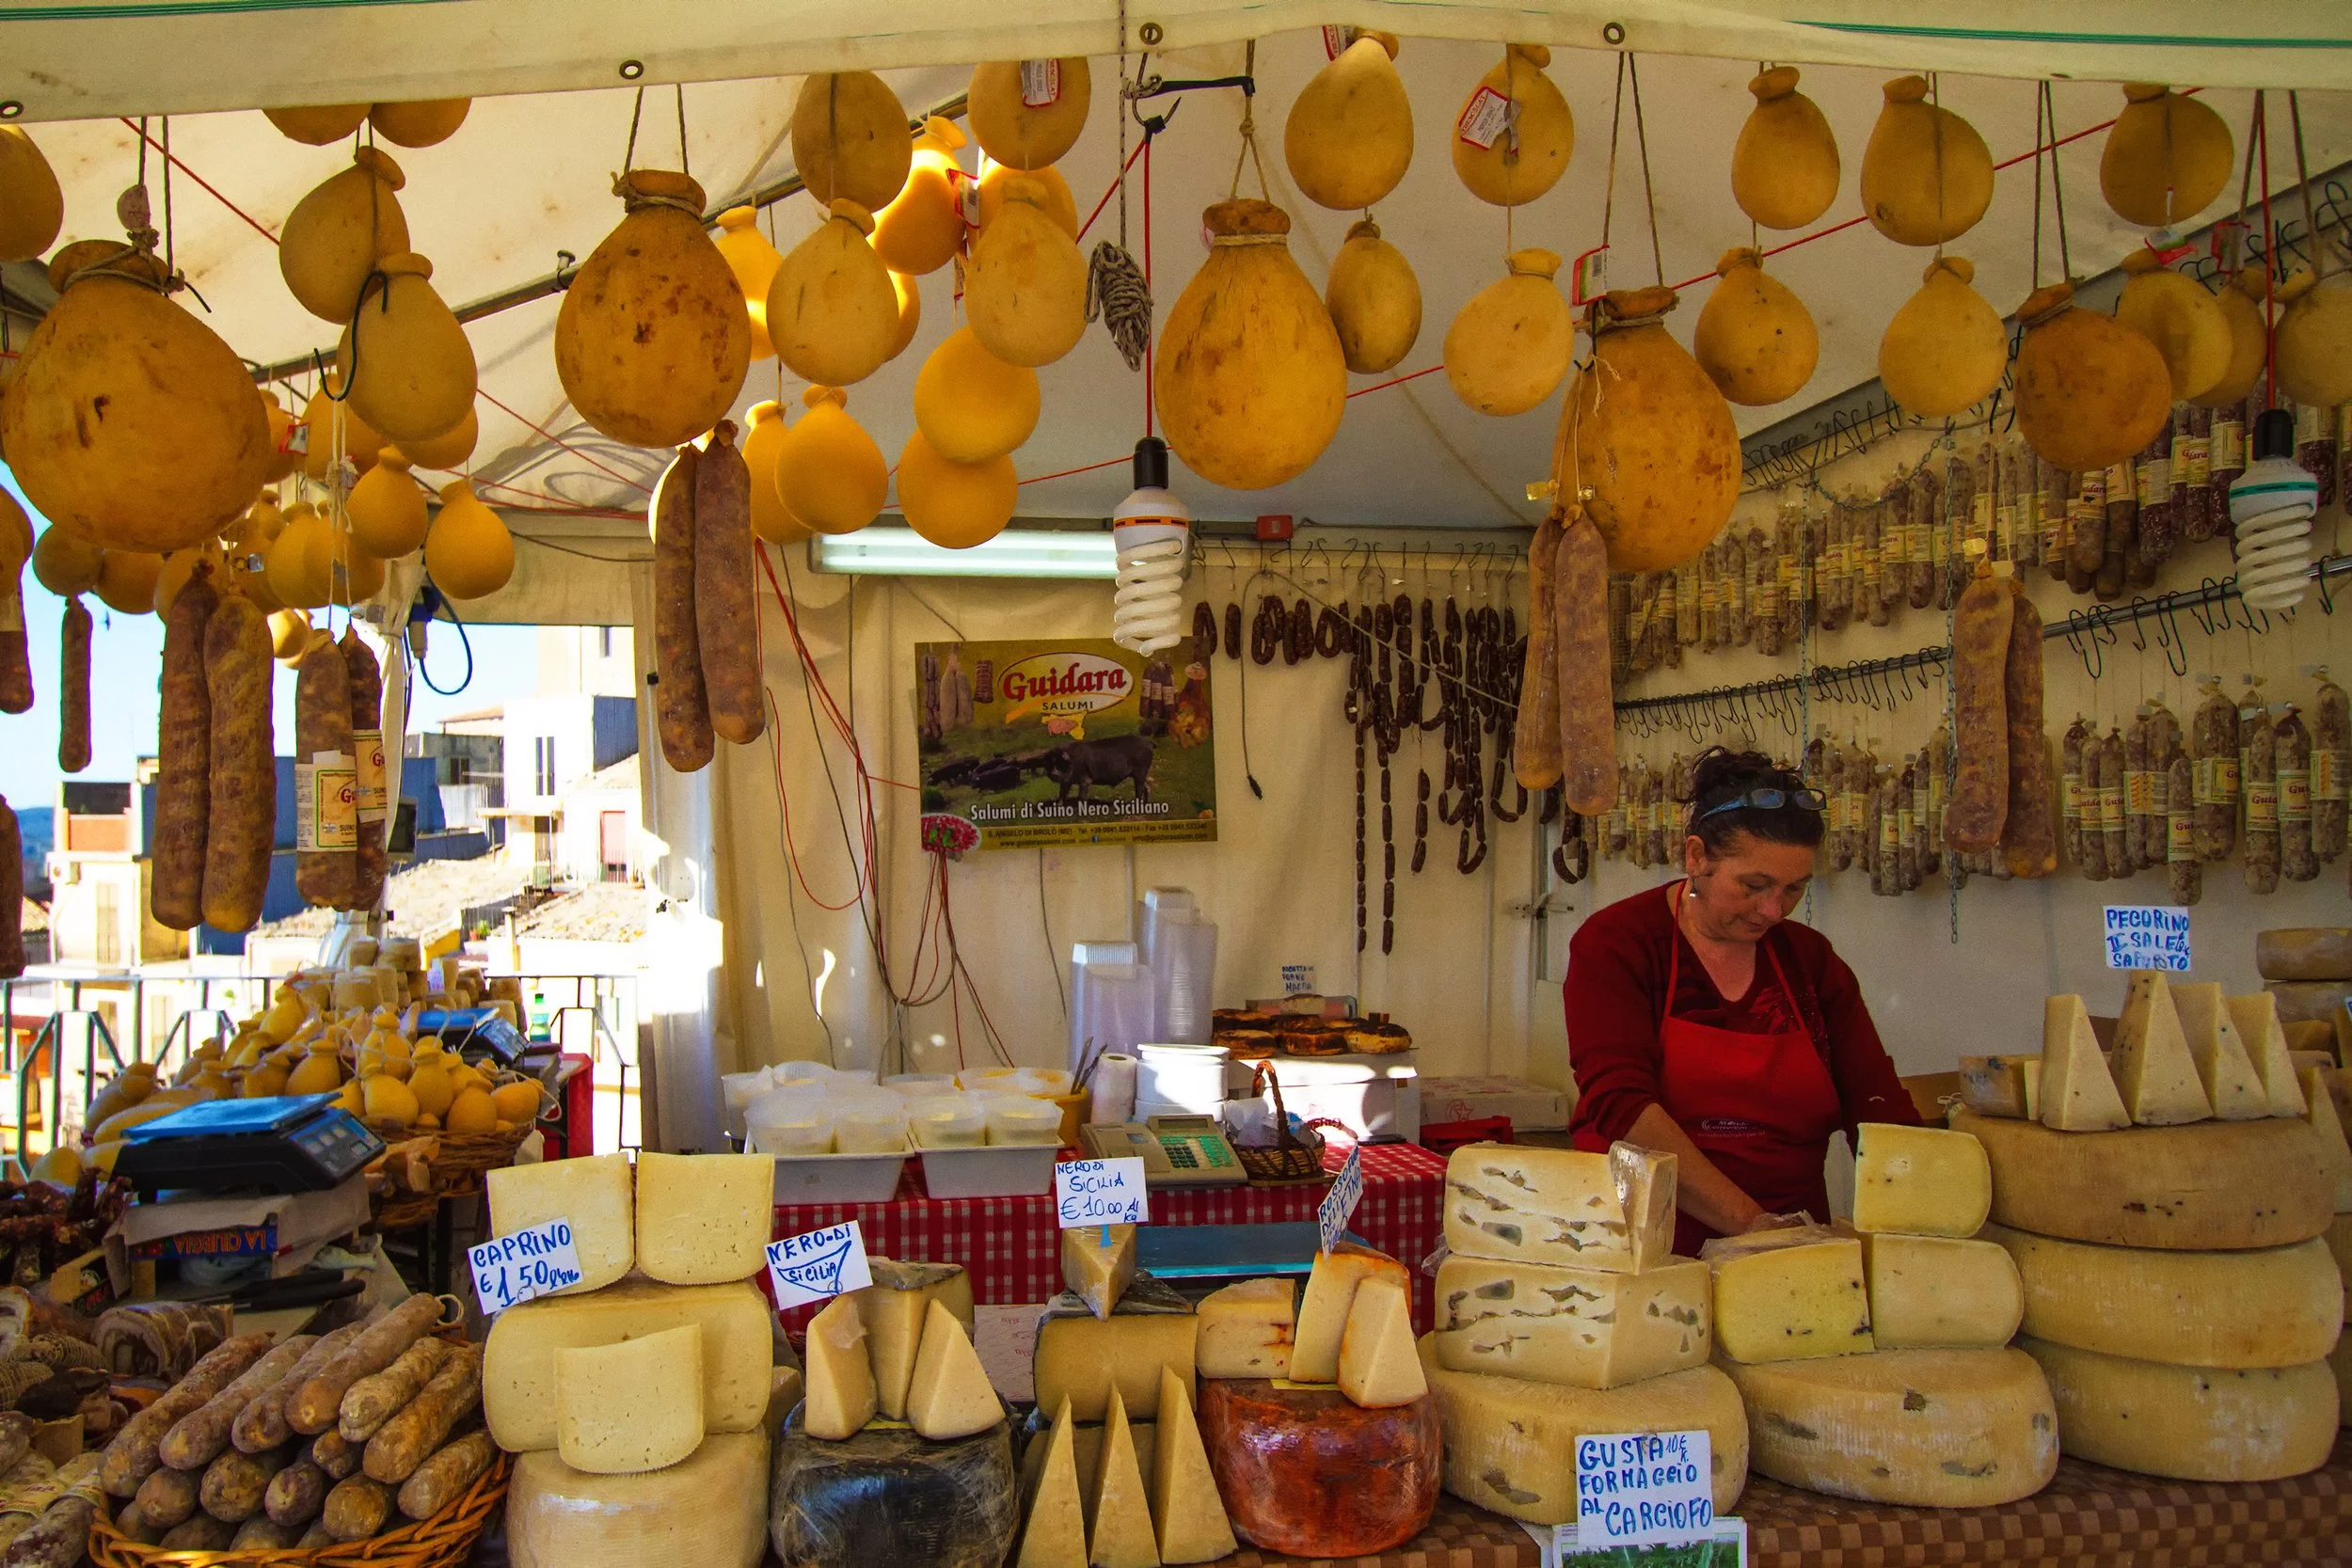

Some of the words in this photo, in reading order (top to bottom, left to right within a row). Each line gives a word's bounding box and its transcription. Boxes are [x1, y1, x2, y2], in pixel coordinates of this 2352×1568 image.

[1003, 662, 1127, 702] Guidara
[1041, 701, 1093, 710] SALUMI
[970, 803, 1016, 821] Salumi
[1020, 802, 1033, 818] di
[1037, 801, 1074, 818] Suino
[1077, 801, 1110, 817] Nero
[1113, 799, 1169, 816] Siciliano
[2106, 909, 2190, 932] PECORINO
[1057, 1160, 1091, 1175] NERO
[1069, 1171, 1124, 1194] SICILIA
[1060, 1196, 1081, 1220] €
[245, 1229, 266, 1251] LA
[473, 1224, 571, 1268] CAPRINO
[1579, 1435, 1664, 1470] GUSTA
[1579, 1462, 1697, 1496] FORMAGGIO
[1581, 1497, 1605, 1517] AL
[1605, 1497, 1712, 1537] CARCIOFO
